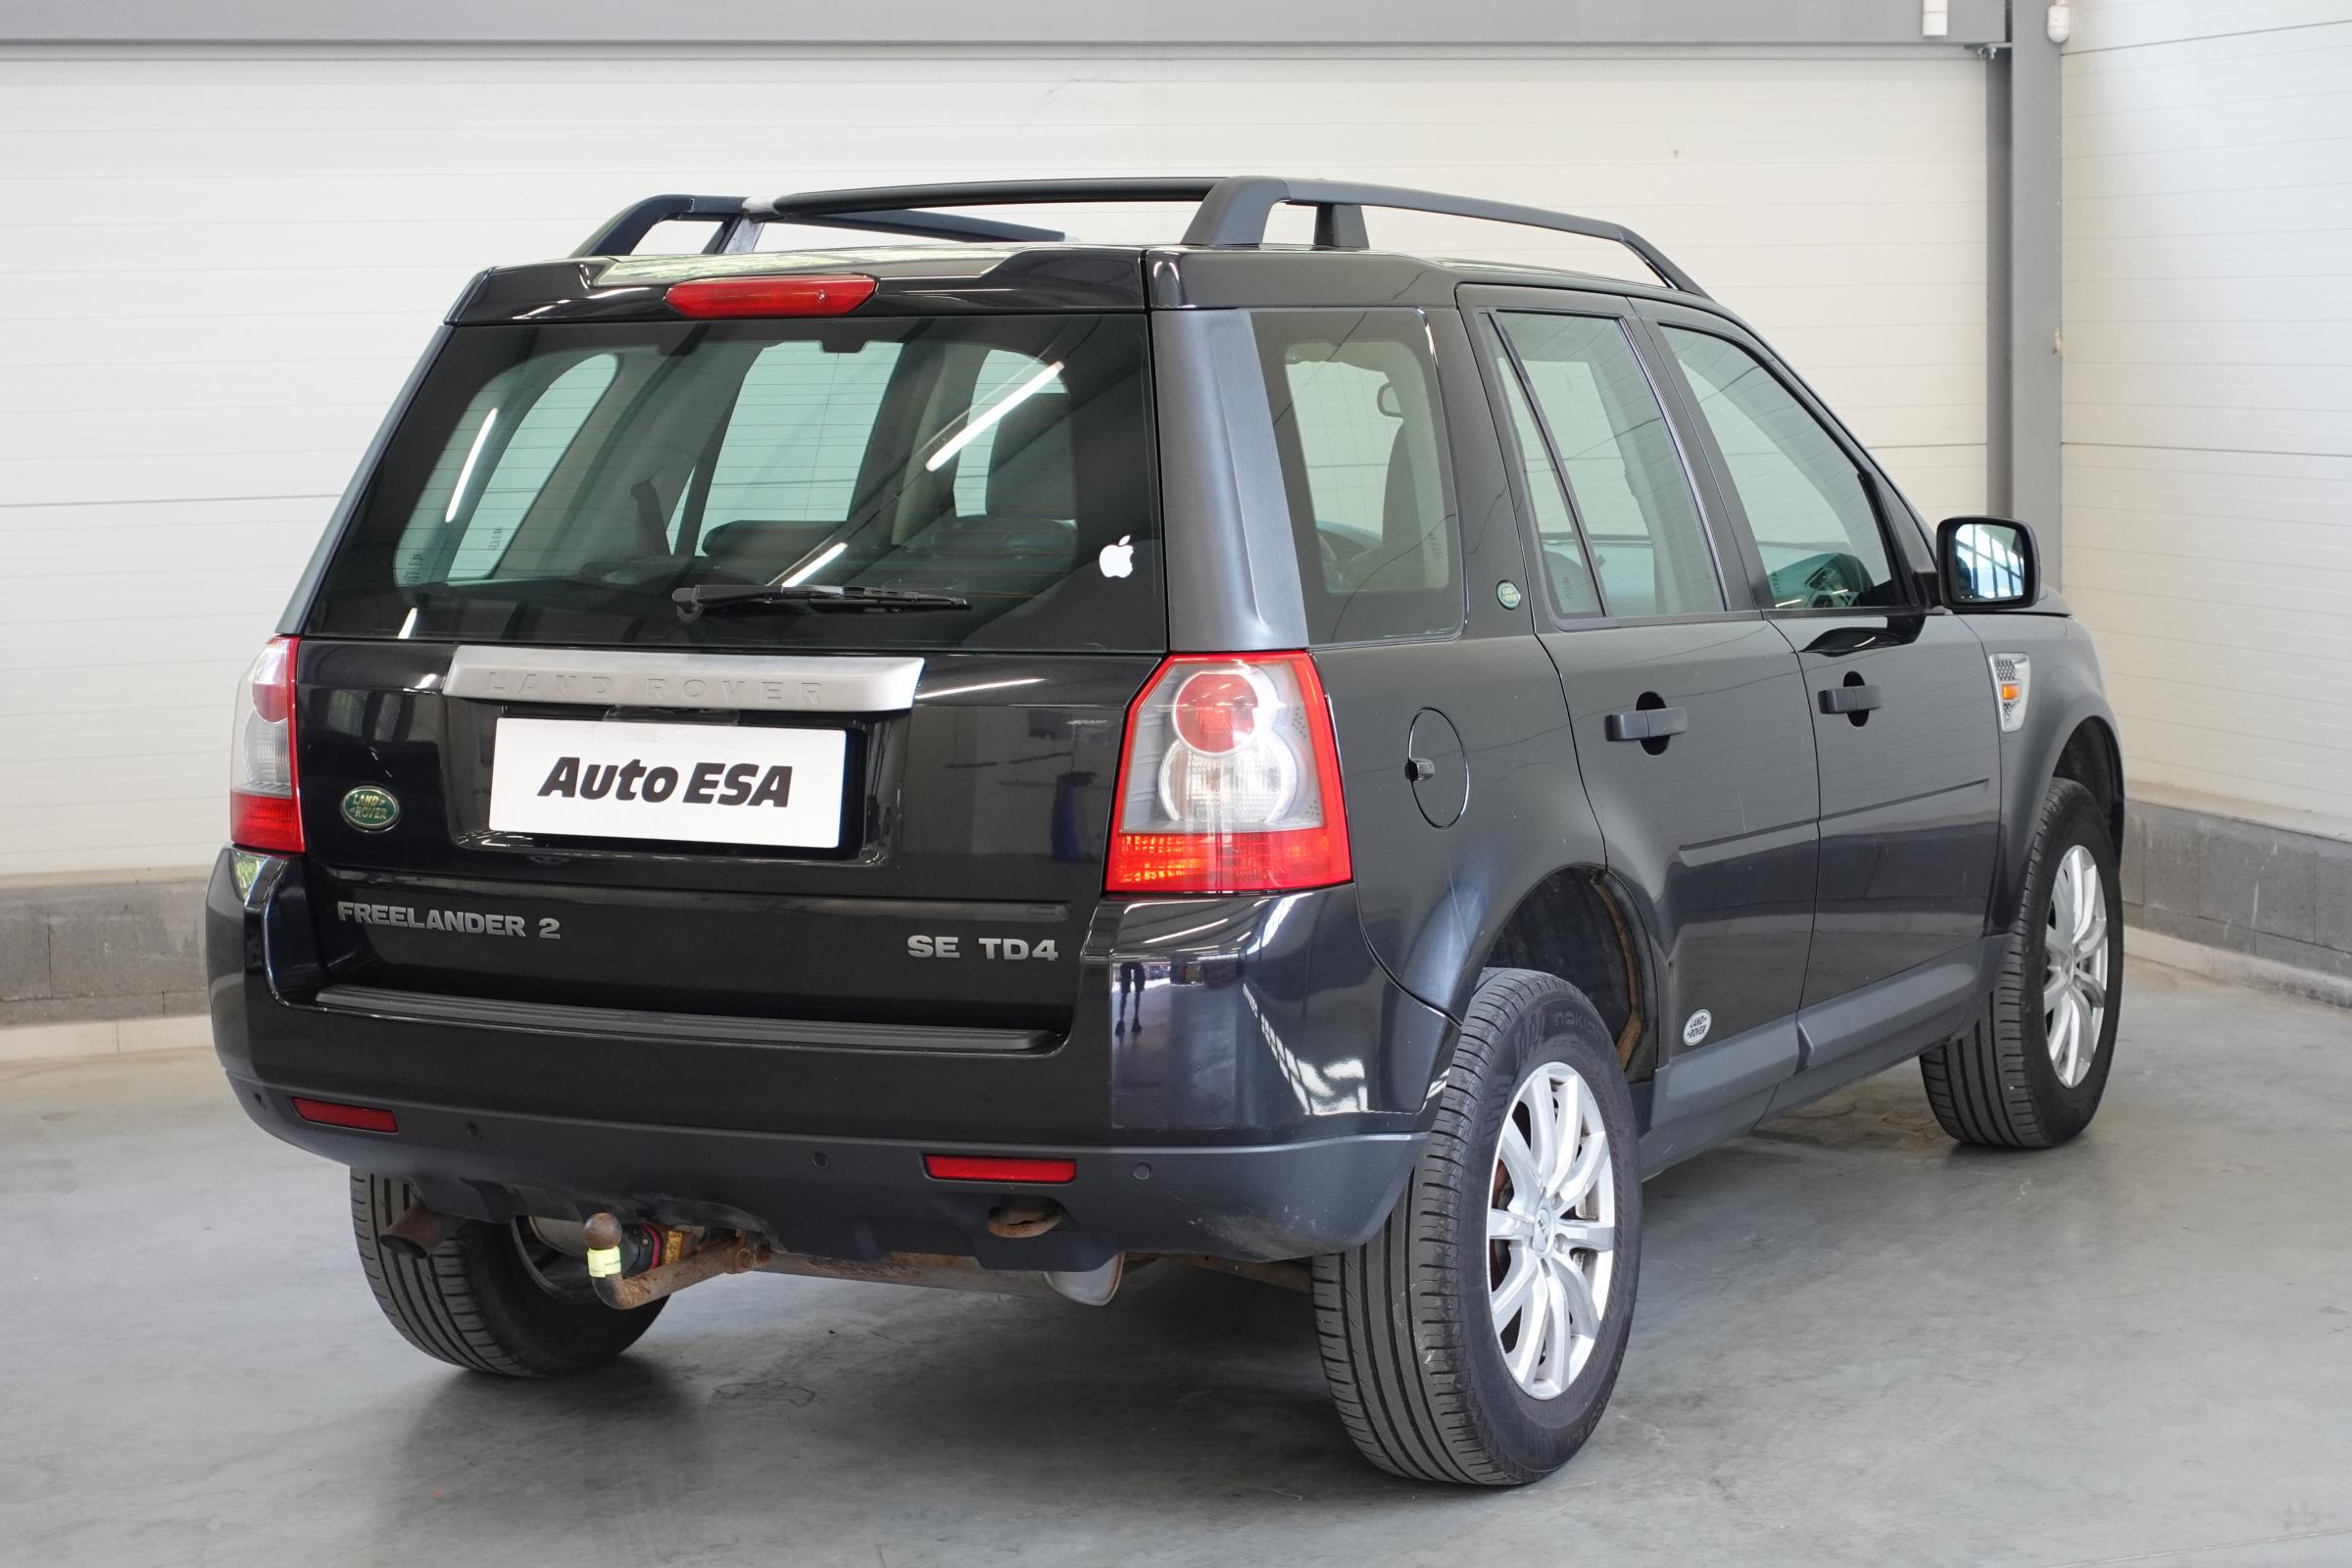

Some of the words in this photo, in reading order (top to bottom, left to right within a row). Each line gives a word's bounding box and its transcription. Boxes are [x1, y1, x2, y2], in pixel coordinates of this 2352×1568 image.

[488, 670, 613, 696] LAND
[646, 677, 825, 707] ROVER
[536, 756, 679, 804] Auto
[682, 761, 793, 808] ESA
[353, 793, 380, 807] LAND
[354, 806, 388, 819] ROVER
[337, 901, 526, 938] FREELANDER
[539, 917, 562, 940] 2
[906, 934, 960, 958] SE
[978, 937, 1059, 961] TD4
